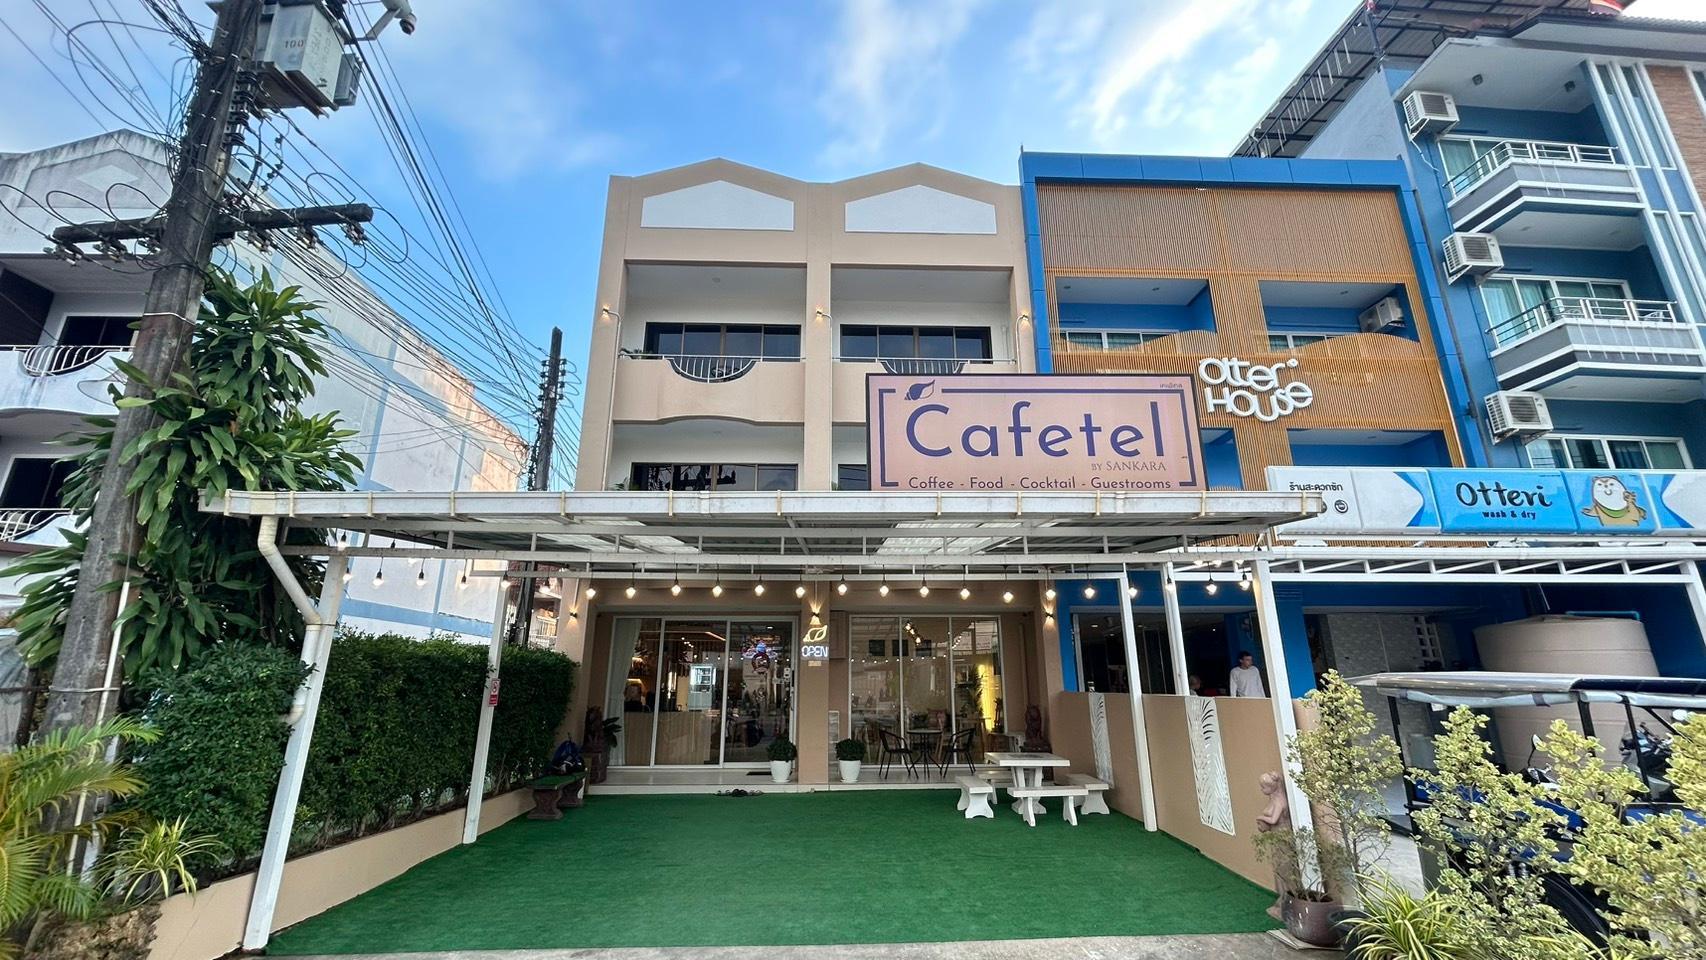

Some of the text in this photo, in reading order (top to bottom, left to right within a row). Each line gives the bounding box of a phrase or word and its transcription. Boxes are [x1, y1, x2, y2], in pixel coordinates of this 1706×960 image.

[284, 40, 304, 48] 100
[906, 401, 1165, 457] Cafetel
[1091, 461, 1167, 471] BY SANKARA
[908, 476, 954, 489] Coffee
[970, 476, 1003, 489] Food
[1020, 475, 1076, 489] Cocktail
[1090, 476, 1171, 489] Guestrooms
[1289, 481, 1344, 491] ร้านสะดวกซัก
[1455, 480, 1553, 507] Otteri
[1482, 510, 1536, 520] wash & dry
[801, 645, 828, 657] OPEN
